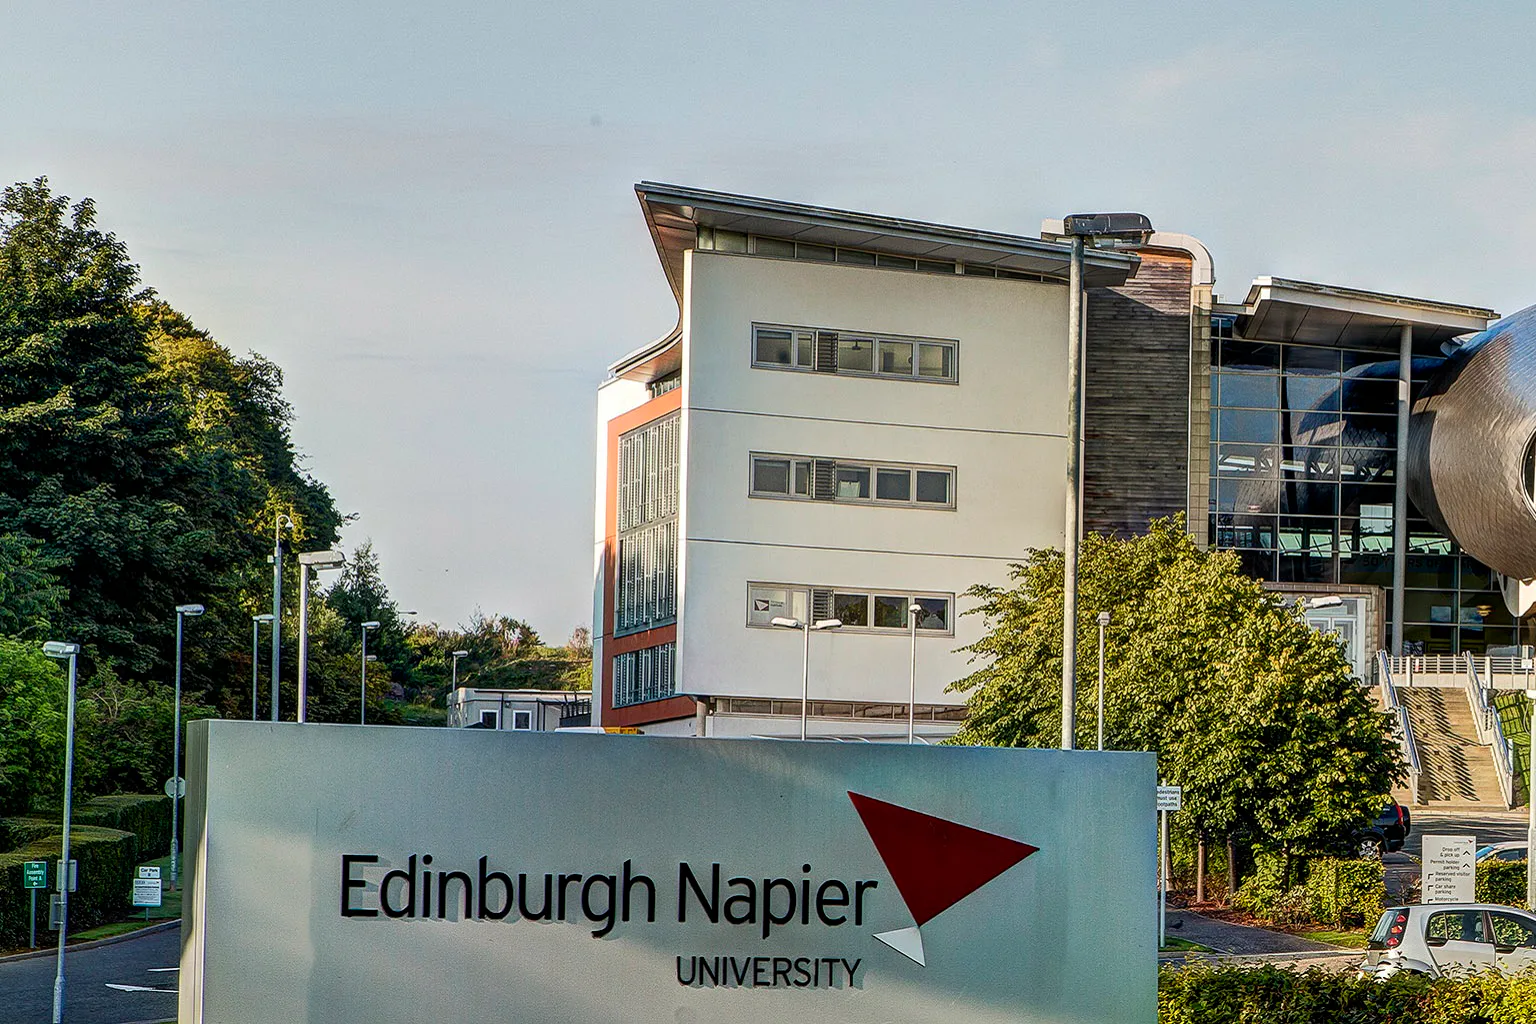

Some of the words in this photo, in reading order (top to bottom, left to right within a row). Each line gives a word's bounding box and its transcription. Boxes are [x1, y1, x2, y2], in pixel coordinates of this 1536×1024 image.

[340, 854, 656, 938] Edinburgh
[677, 862, 878, 939] Napier
[676, 956, 862, 988] UNIVERSITY
